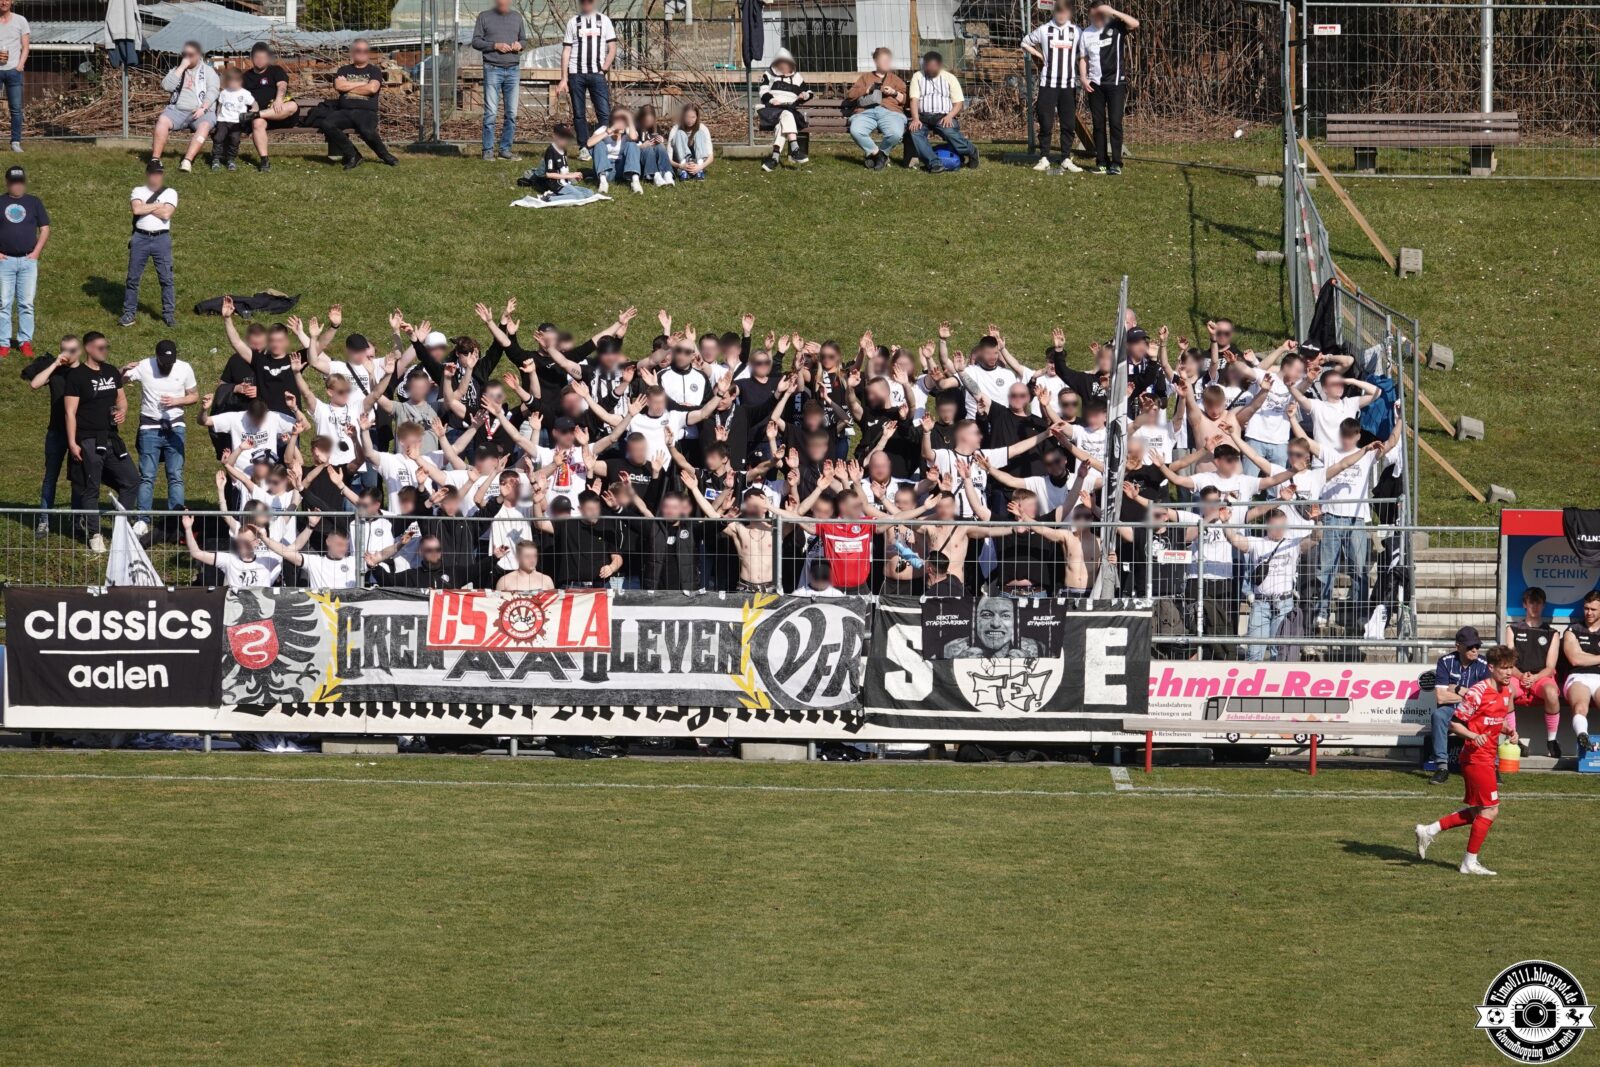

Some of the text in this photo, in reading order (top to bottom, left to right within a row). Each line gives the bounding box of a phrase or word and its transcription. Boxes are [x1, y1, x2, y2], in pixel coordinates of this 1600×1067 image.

[1533, 568, 1588, 579] TECHNIK
[1536, 554, 1577, 564] STARK
[24, 601, 212, 641] classics
[429, 591, 611, 647] CS LA
[68, 661, 169, 690] aalen
[1148, 667, 1420, 700] chmid-Reisen
[1370, 707, 1385, 715] wie
[1385, 707, 1398, 715] die
[1400, 706, 1432, 717] Könige!
